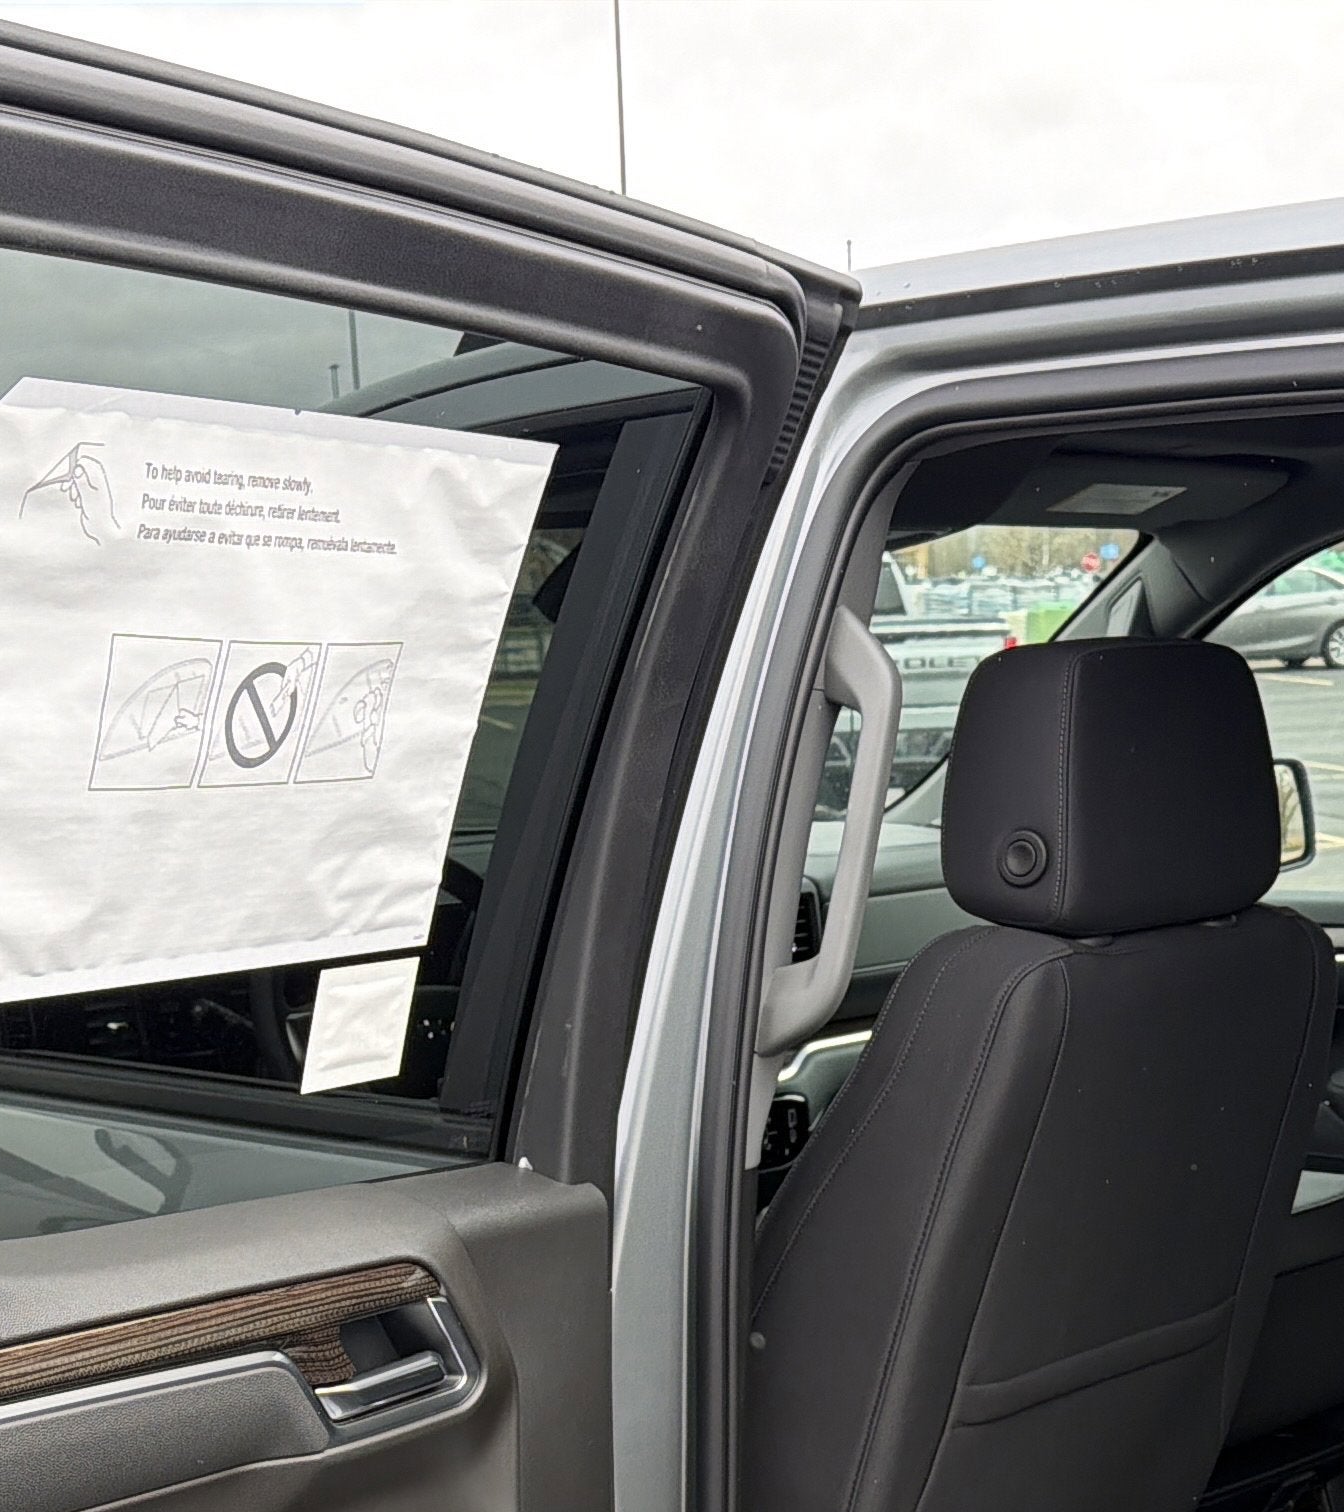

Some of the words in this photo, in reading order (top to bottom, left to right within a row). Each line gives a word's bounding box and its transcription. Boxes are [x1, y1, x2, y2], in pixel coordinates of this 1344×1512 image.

[145, 462, 158, 480] To
[161, 464, 182, 485] help
[184, 468, 211, 484] avoid
[213, 470, 245, 490] tearing,
[247, 475, 280, 489] remove
[282, 475, 313, 496] slowly.
[141, 493, 167, 510] Pour
[168, 495, 196, 513] éviter
[199, 499, 222, 515] toute
[268, 504, 296, 519] retirer
[137, 523, 160, 540] Para
[161, 526, 206, 544] ayudarse
[208, 531, 216, 543] a
[218, 530, 244, 546] evitar
[245, 534, 260, 550] que
[262, 534, 272, 547] se
